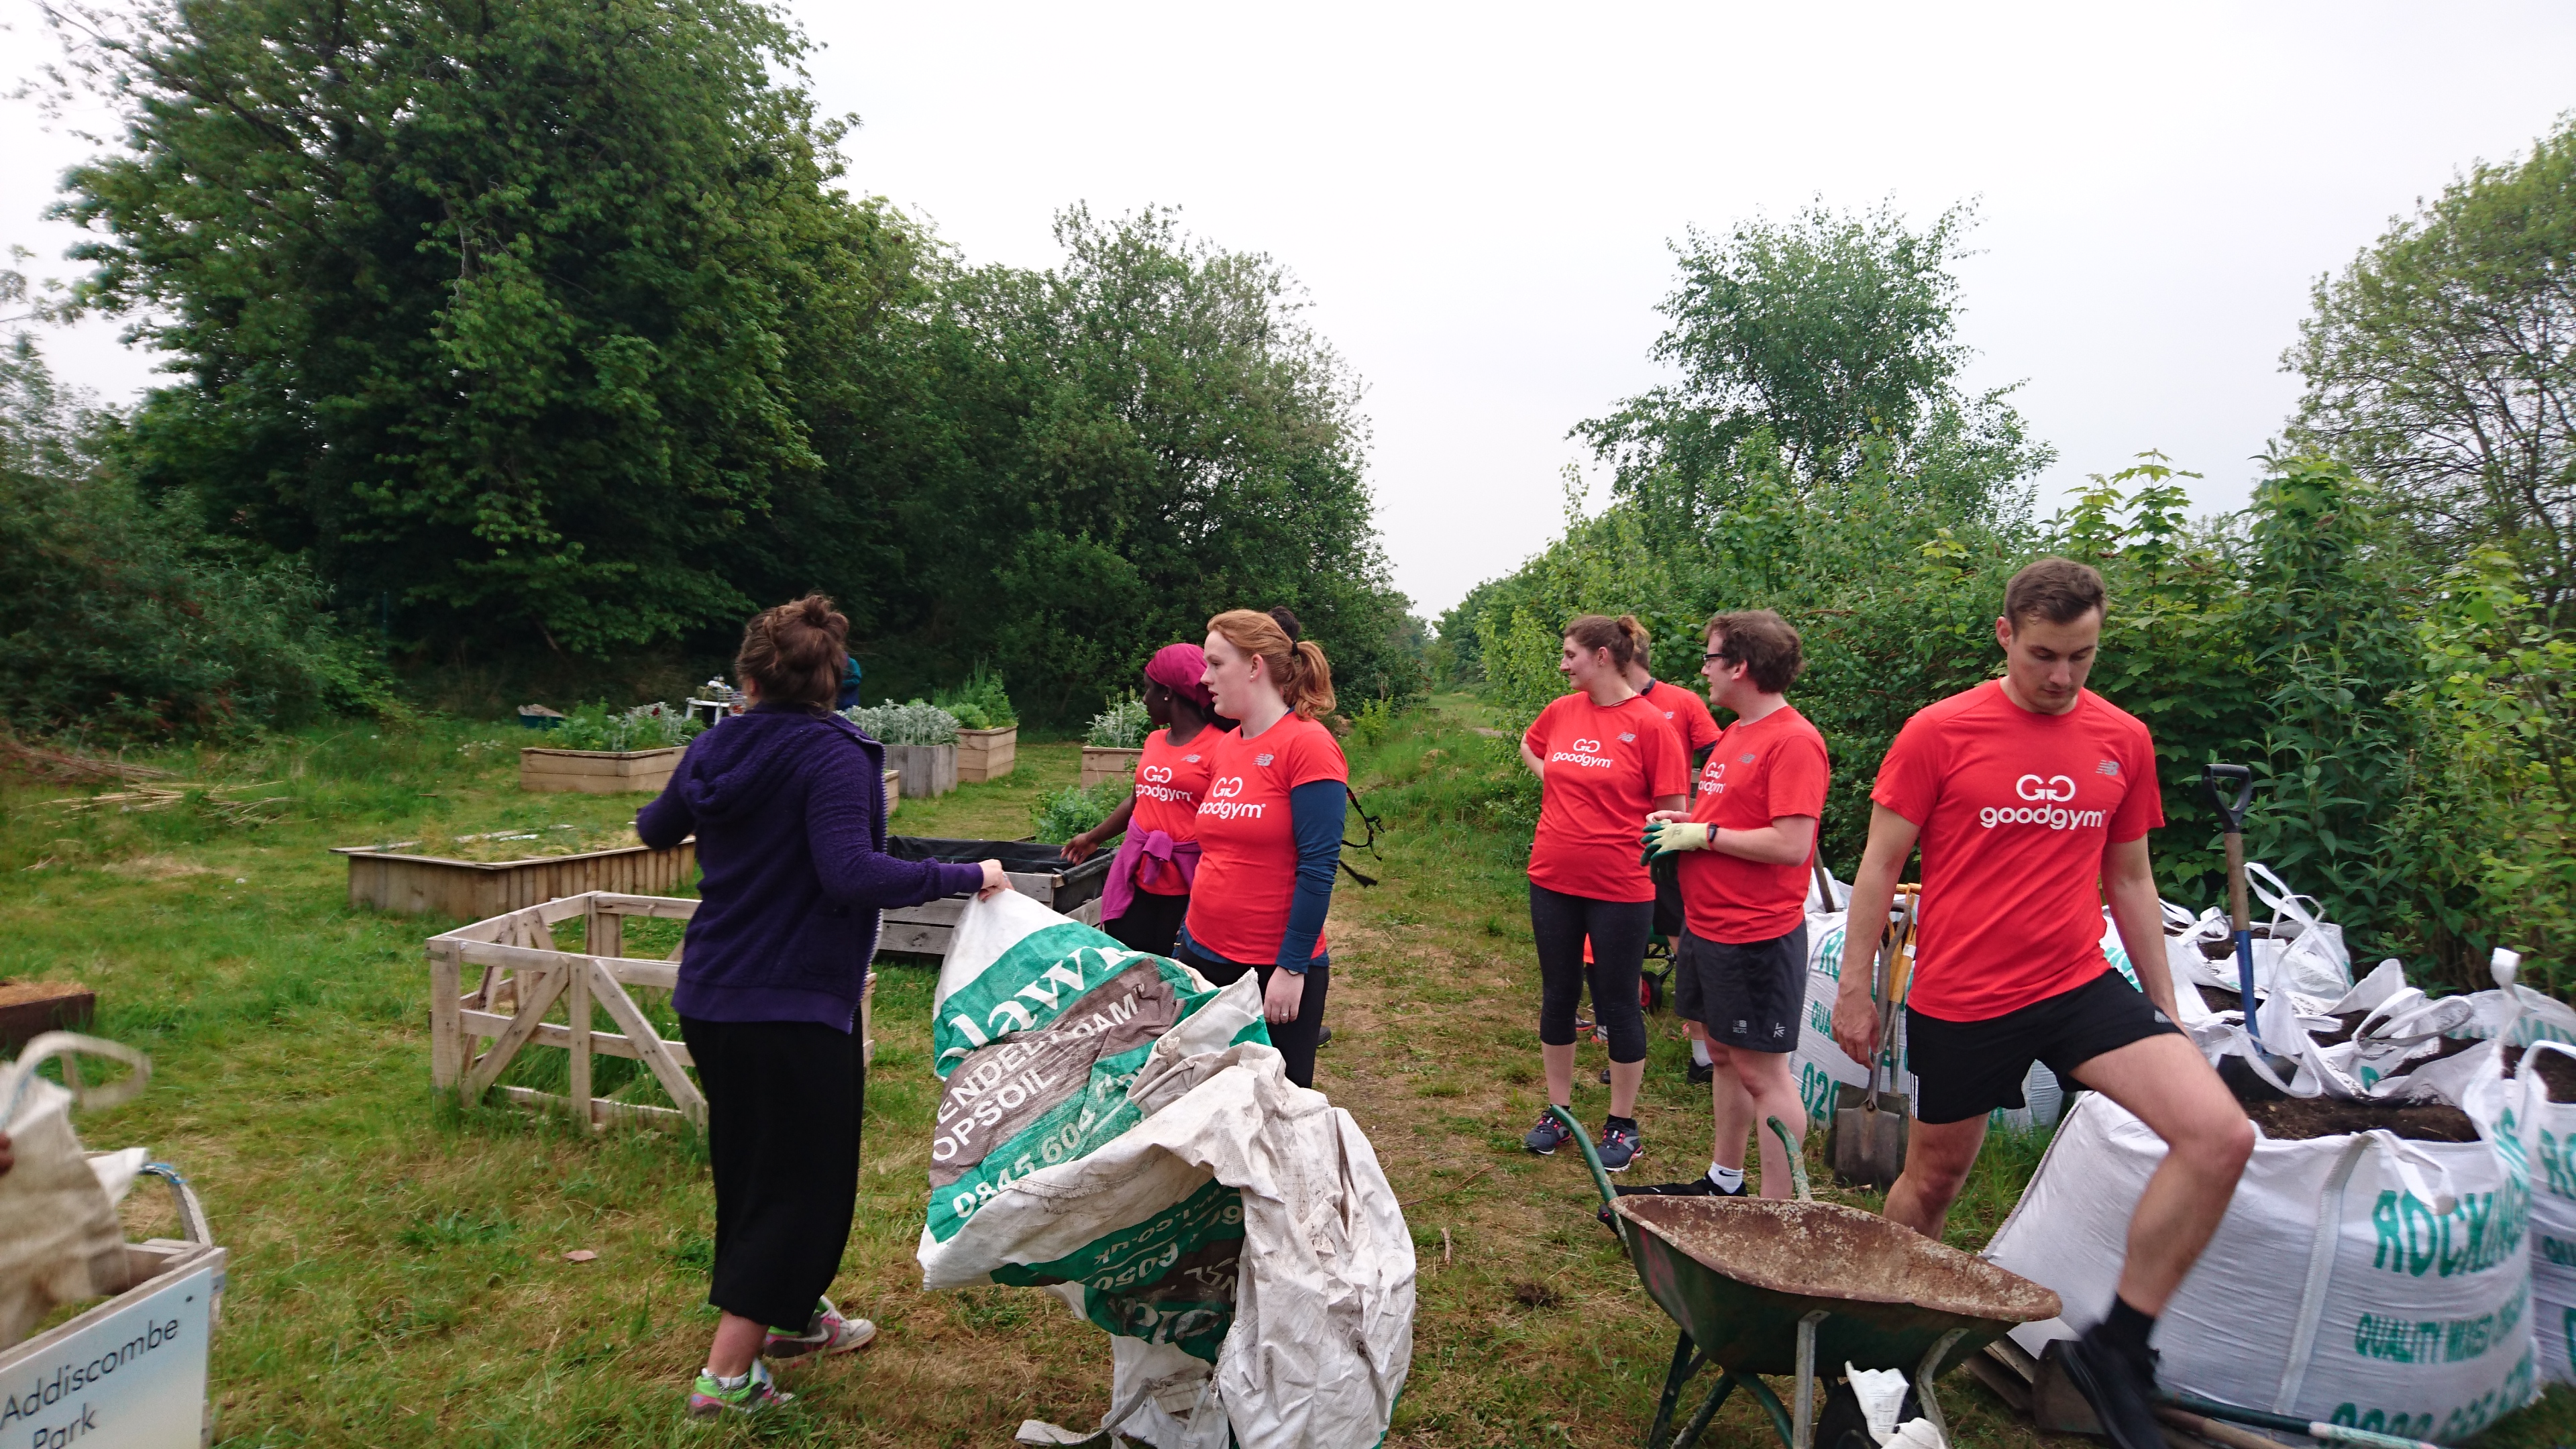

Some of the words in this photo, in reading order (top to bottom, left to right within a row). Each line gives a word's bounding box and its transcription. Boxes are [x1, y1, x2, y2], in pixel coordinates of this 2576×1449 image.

[1552, 752, 1611, 768] goodgym
[1198, 799, 1266, 819] oodgym
[1980, 804, 2103, 830] goodgym
[932, 1069, 1057, 1161] OPSOIL
[0, 1319, 178, 1430] Addiscombe
[34, 1402, 96, 1449] Park
